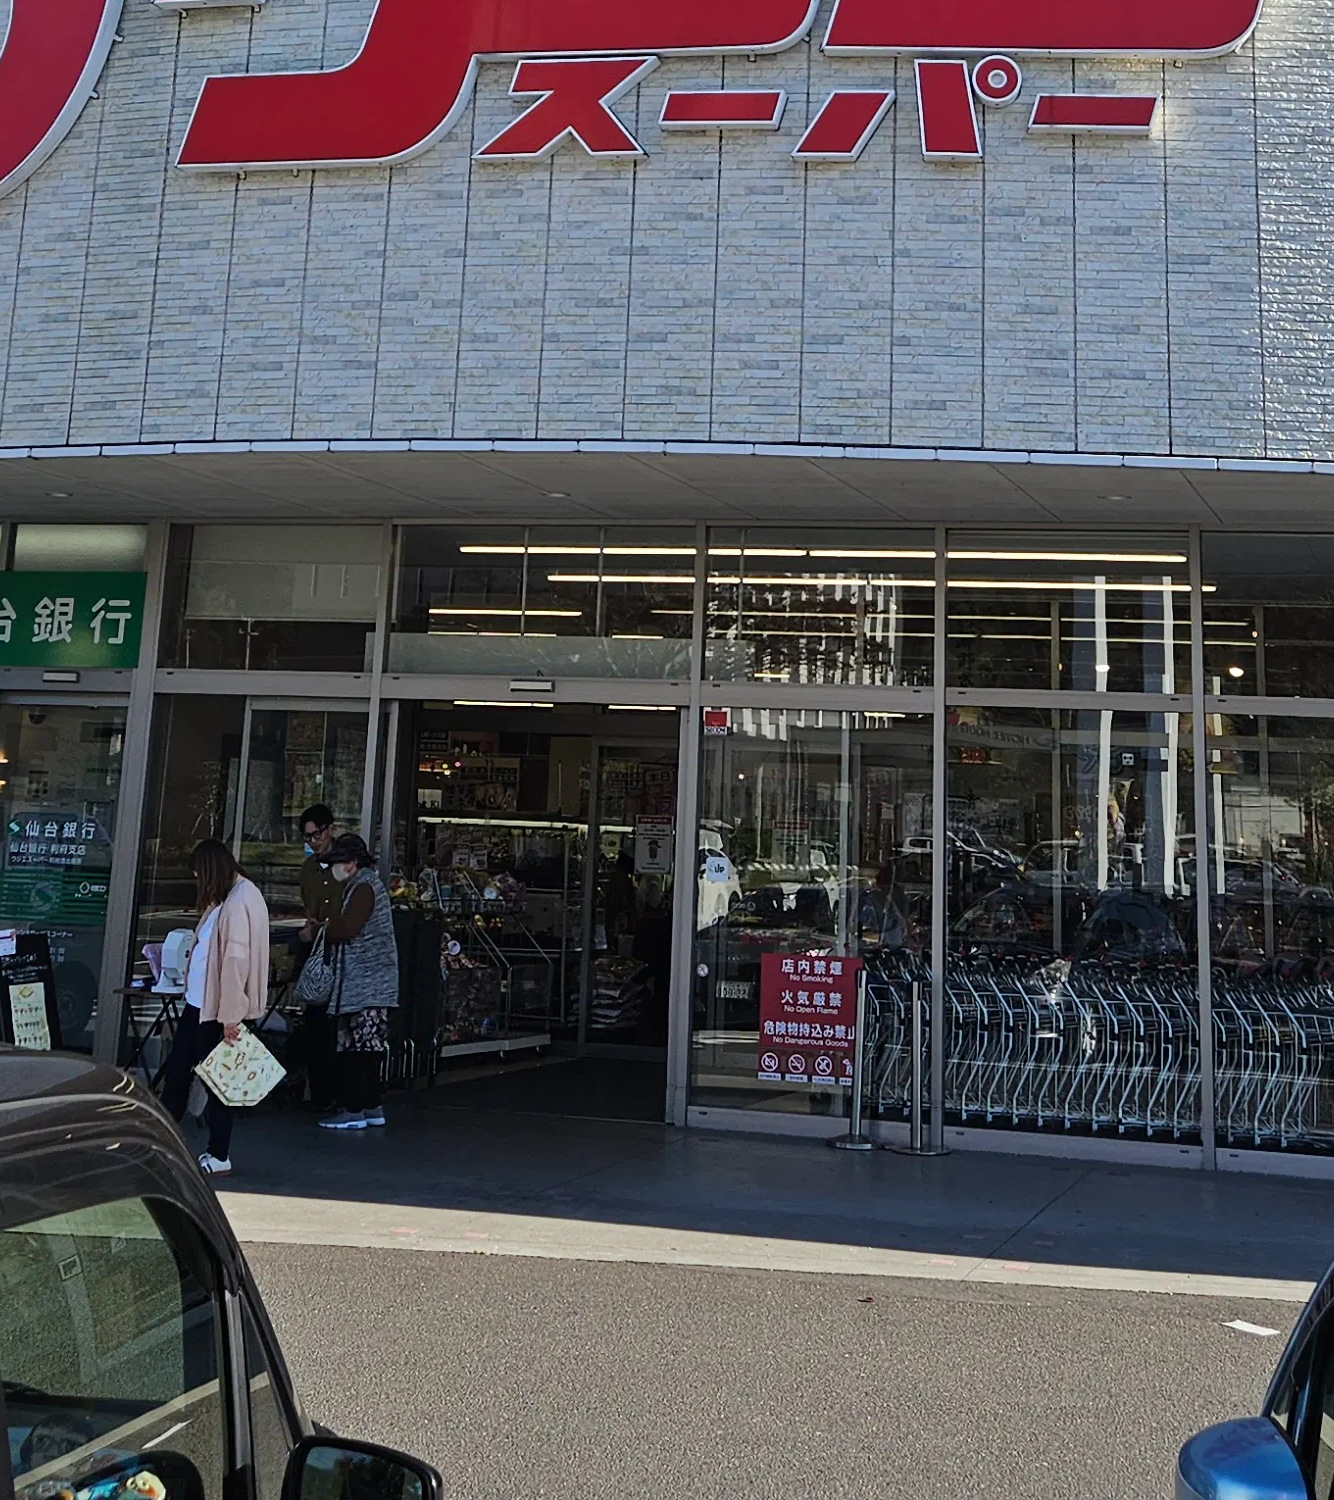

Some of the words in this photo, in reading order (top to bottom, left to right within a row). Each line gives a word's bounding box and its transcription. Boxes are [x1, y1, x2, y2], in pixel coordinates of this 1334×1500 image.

[477, 57, 1159, 160] スーパー
[25, 819, 96, 839] 仙台銀行
[781, 959, 843, 975] 店内禁煙
[789, 974, 800, 982] No
[802, 975, 834, 984] Smoking
[781, 990, 843, 1007] 火気厳禁
[784, 1005, 795, 1013] No
[796, 1006, 815, 1014] Open
[816, 1007, 839, 1015] Flame
[784, 1037, 824, 1047] Dangerous
[825, 1039, 848, 1048] Goods
